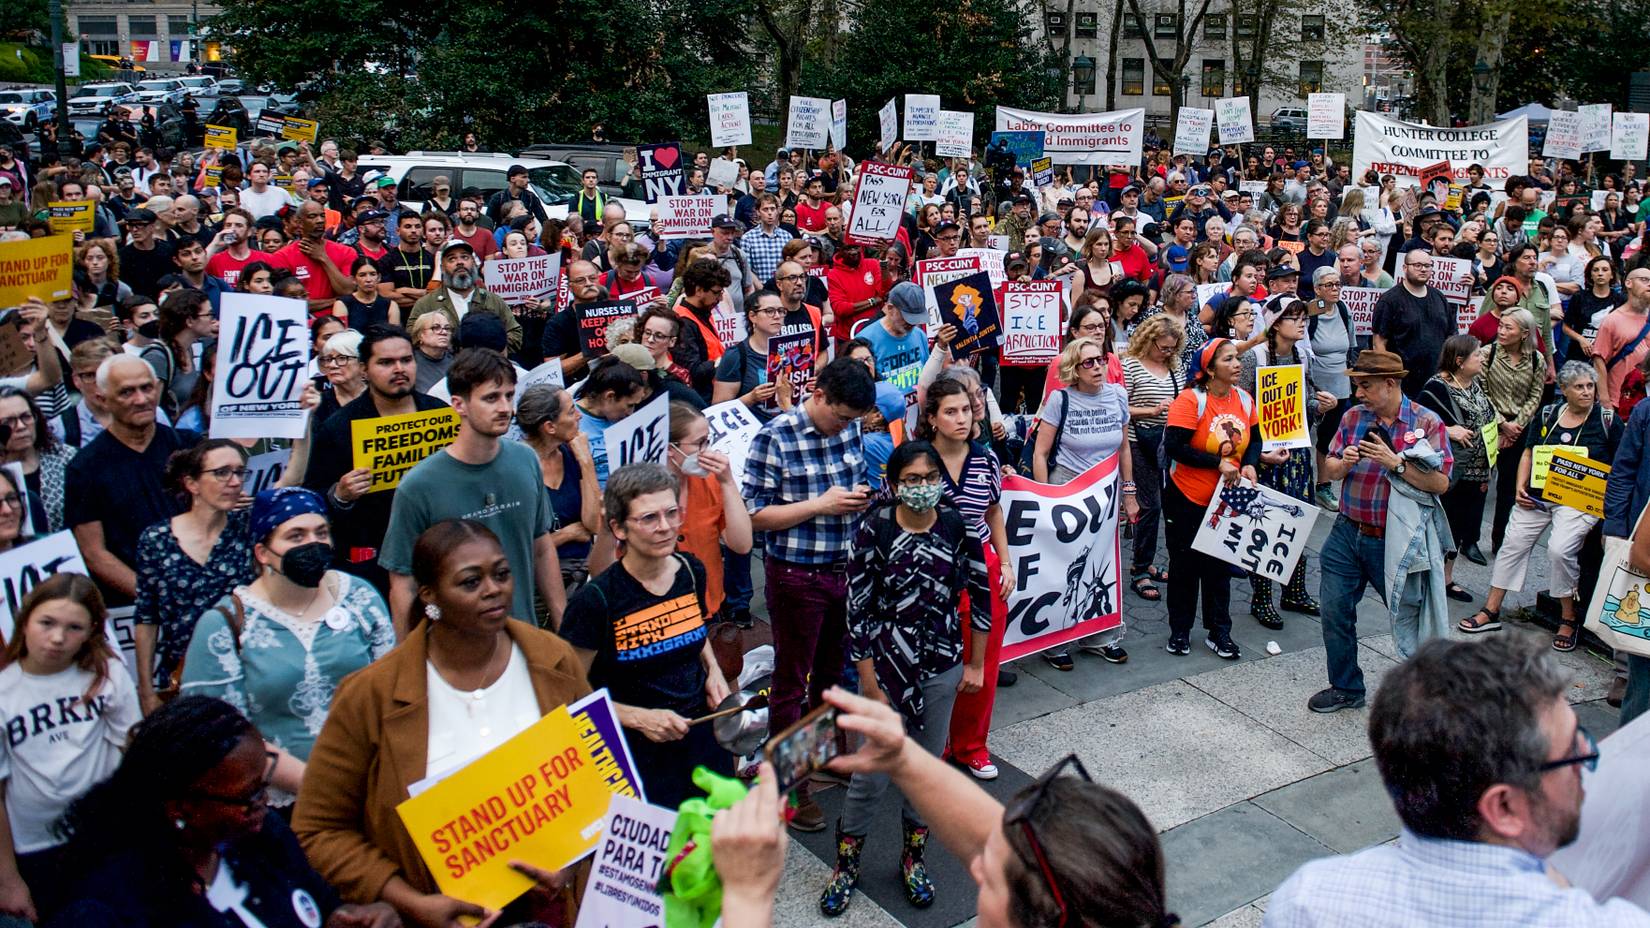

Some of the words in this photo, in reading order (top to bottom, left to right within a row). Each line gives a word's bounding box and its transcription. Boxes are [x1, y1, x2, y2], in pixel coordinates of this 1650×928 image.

[1007, 119, 1042, 131] Labor
[1046, 121, 1117, 133] Committee
[1119, 122, 1132, 132] to
[1383, 126, 1434, 141] HUNTER
[1437, 129, 1498, 142] COLLEGE
[1056, 135, 1129, 147] Immigrants
[1391, 144, 1468, 160] COMMITTEE
[1471, 148, 1490, 160] TO
[640, 149, 656, 172] I
[642, 168, 682, 179] IMMIGRANT
[866, 163, 911, 178] PSC-CUNY
[645, 175, 682, 201] NY
[668, 199, 693, 208] STOP
[696, 198, 714, 208] THE
[860, 189, 881, 206] NEW
[882, 191, 904, 207] YORK
[674, 208, 696, 218] WAR
[698, 208, 712, 217] ON
[870, 207, 886, 217] FOR
[0, 259, 31, 274] TAND
[33, 256, 48, 269] UP
[51, 252, 70, 267] FOR
[497, 261, 526, 274] STOP
[528, 258, 548, 271] THE
[925, 259, 974, 272] PSC-CUNY
[1436, 260, 1457, 272] THE
[0, 268, 59, 288] ANCTUARY
[503, 271, 528, 283] WAR
[531, 269, 545, 280] ON
[1438, 271, 1453, 282] ON
[488, 275, 556, 294] IMMIGRANTS!
[1008, 282, 1057, 292] PSC-CUNY
[1009, 294, 1055, 310] STOP
[1341, 290, 1367, 301] STOP
[1370, 291, 1383, 301] TH
[585, 305, 620, 318] NURSES
[620, 305, 632, 314] SAY
[580, 316, 606, 329] KEEP
[716, 317, 737, 331] THE
[777, 323, 814, 336] BOLISH
[1011, 315, 1046, 331] ICE
[229, 312, 303, 369] ICE
[719, 331, 734, 343] ON
[777, 340, 799, 351] SHOW
[801, 338, 811, 347] UP
[225, 359, 307, 401] OUT
[1261, 371, 1278, 389] ICE
[1262, 386, 1283, 405] OUT
[1285, 380, 1299, 397] OF
[219, 405, 238, 413] OF
[239, 403, 270, 412] NEW
[1262, 396, 1296, 422] NEW
[375, 418, 428, 435] PROTECT
[428, 414, 453, 426] OUR
[707, 406, 751, 445] ICE
[1263, 412, 1303, 440] YORK!
[362, 423, 461, 454] FREEDOMS
[1553, 465, 1567, 476] FOR
[1567, 470, 1580, 479] ALL
[1556, 457, 1573, 468] PASS
[1573, 462, 1588, 473] NEW
[1587, 466, 1605, 479] YORK
[1241, 528, 1269, 573] OUT
[1265, 523, 1297, 577] ICE
[615, 613, 673, 638] STAND
[615, 630, 665, 652] WITH
[6, 694, 107, 748] BRKN
[48, 730, 70, 745] AVE
[573, 711, 642, 800] HEALTHCAR
[430, 795, 508, 855] STAND
[506, 773, 538, 809] UP
[540, 746, 585, 788] FOR
[444, 784, 575, 880] SANCTUARY
[602, 838, 645, 875] PARA
[594, 881, 661, 917] #LIBRESYUNIDOS
